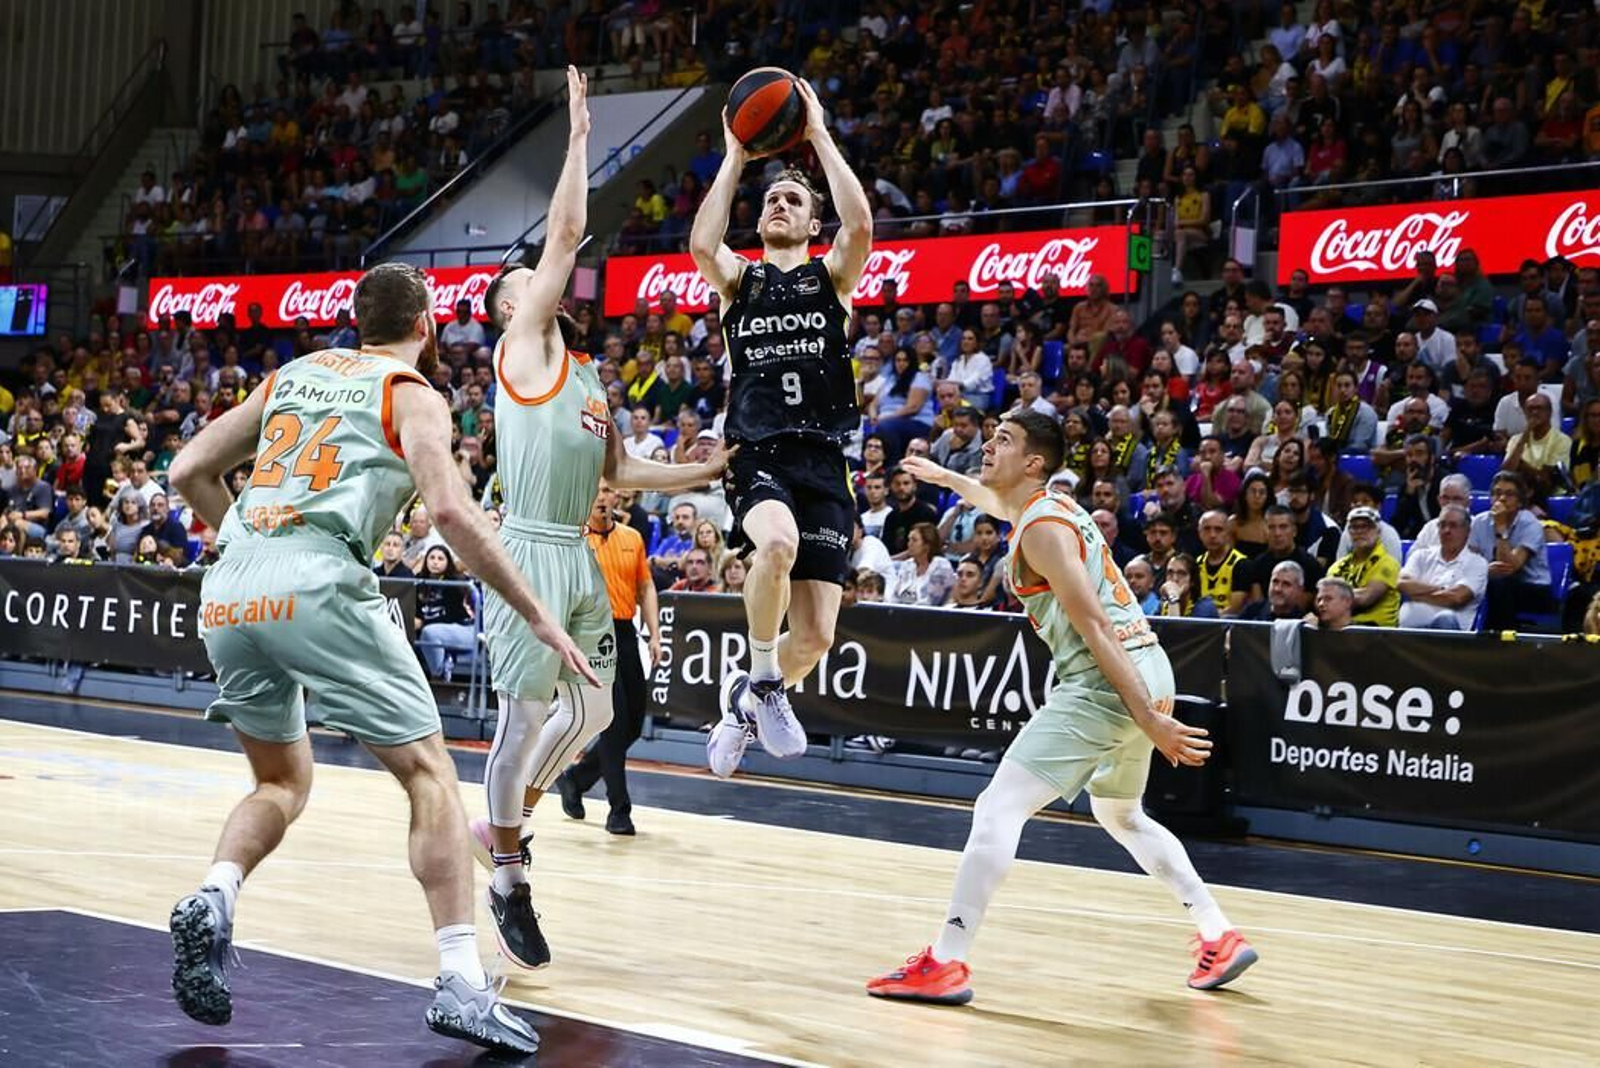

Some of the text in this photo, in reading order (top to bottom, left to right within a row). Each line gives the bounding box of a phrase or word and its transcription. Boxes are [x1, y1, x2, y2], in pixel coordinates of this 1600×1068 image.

[1136, 242, 1148, 264] C
[738, 311, 827, 338] Lenovo
[295, 384, 367, 404] AMUTIO
[781, 371, 803, 406] 9
[249, 412, 344, 493] 24
[1270, 737, 1475, 783] Deportes Natalia
